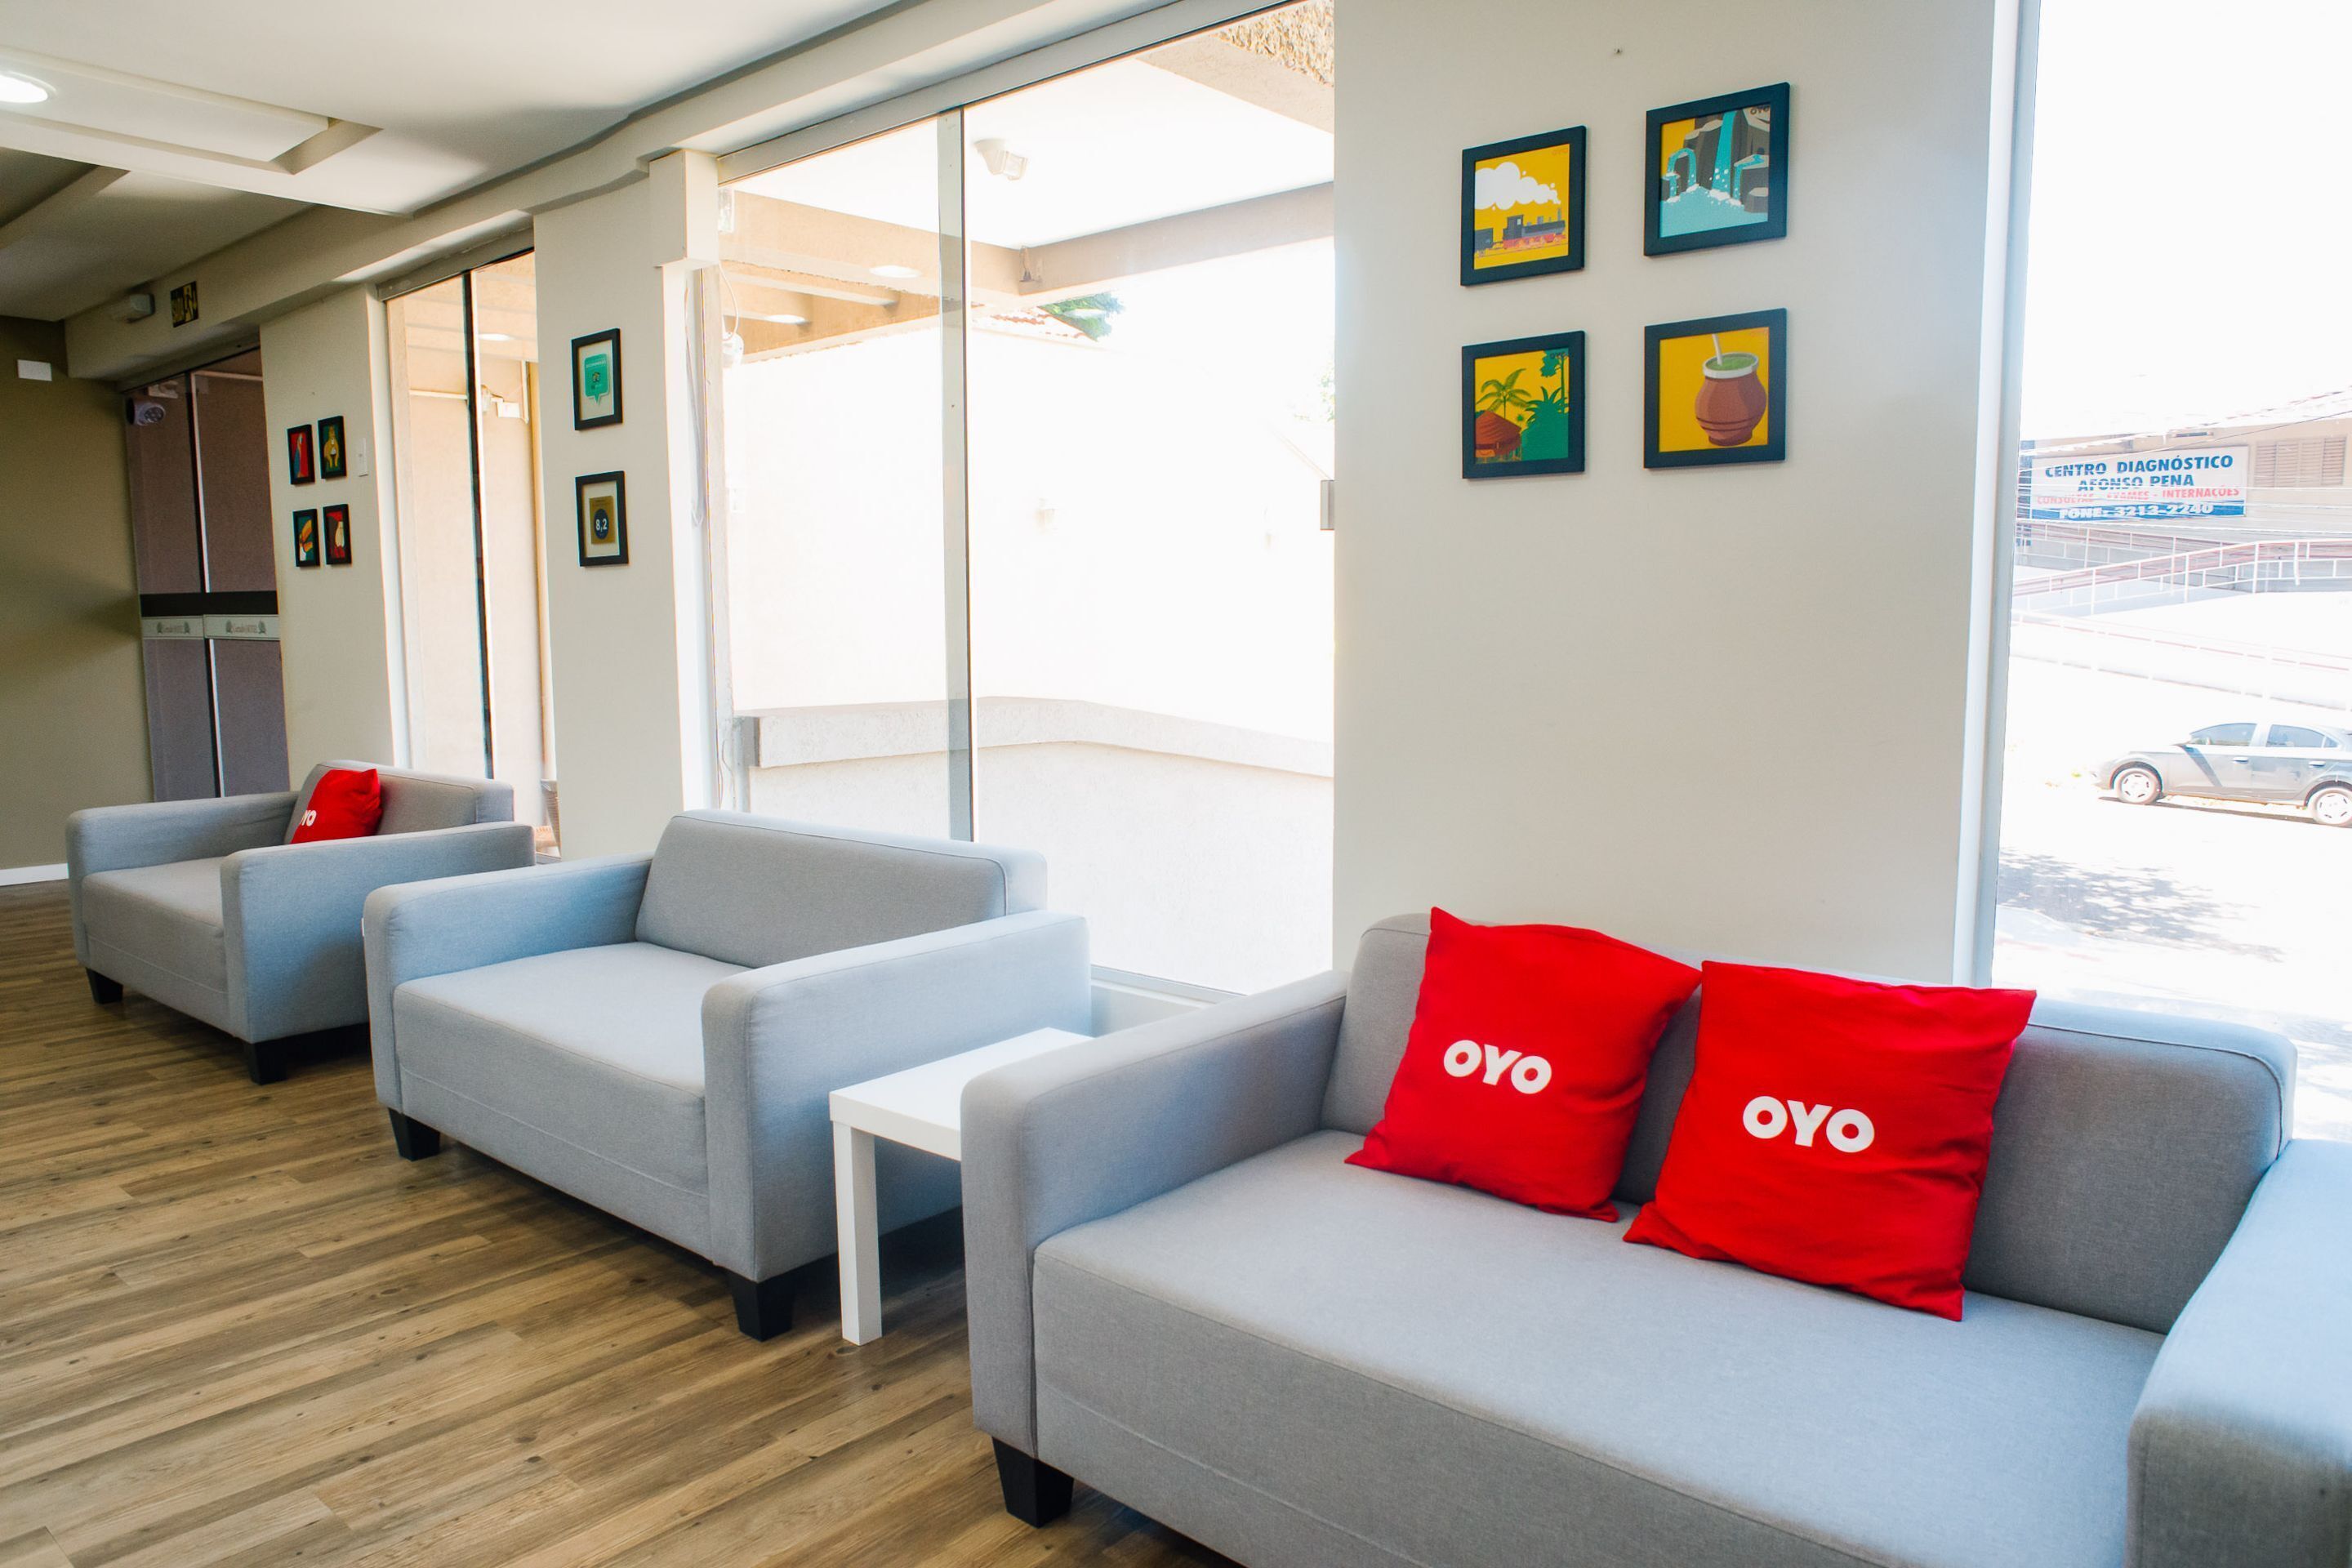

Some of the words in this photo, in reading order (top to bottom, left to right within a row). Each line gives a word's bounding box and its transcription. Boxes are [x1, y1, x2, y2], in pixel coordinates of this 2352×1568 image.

[2045, 462, 2107, 478] CENTRO
[2117, 455, 2234, 474] DIAGNÓSTICO
[2078, 476, 2143, 492] AFONSO
[2149, 474, 2194, 487] PENA
[595, 519, 608, 532] 8,2
[1444, 1040, 1552, 1094] OYO
[1743, 1096, 1875, 1153] OYO
